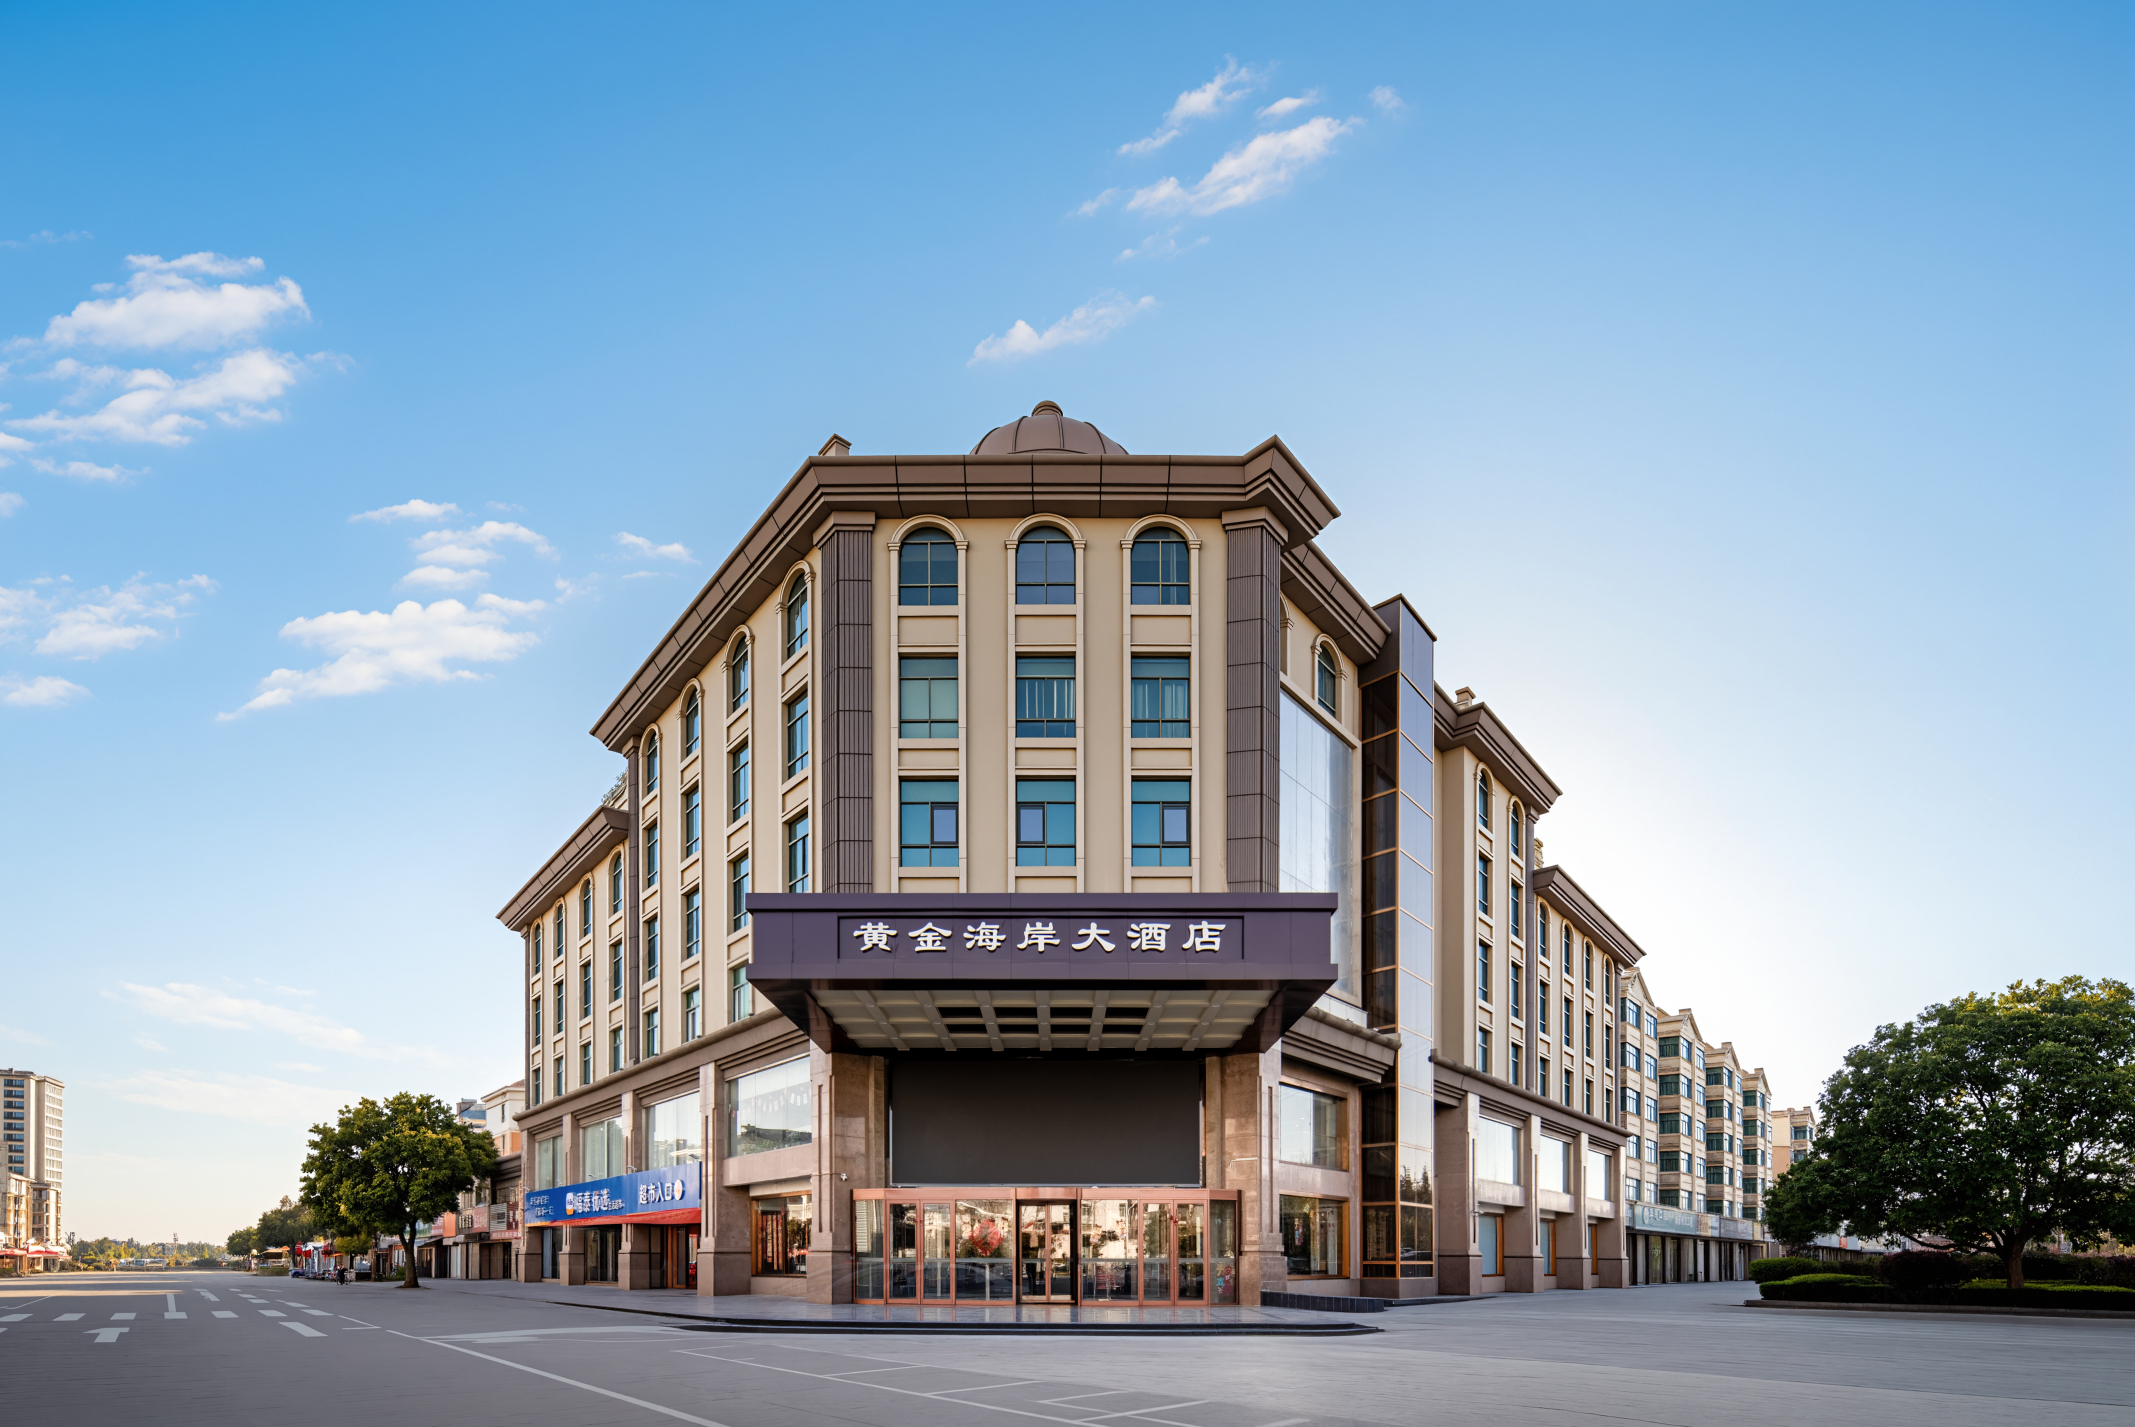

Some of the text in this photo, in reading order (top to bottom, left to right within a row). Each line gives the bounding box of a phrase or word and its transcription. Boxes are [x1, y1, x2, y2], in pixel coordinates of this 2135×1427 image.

[853, 920, 1227, 953] 黄金海岸大酒店
[638, 1181, 673, 1205] 超市入口
